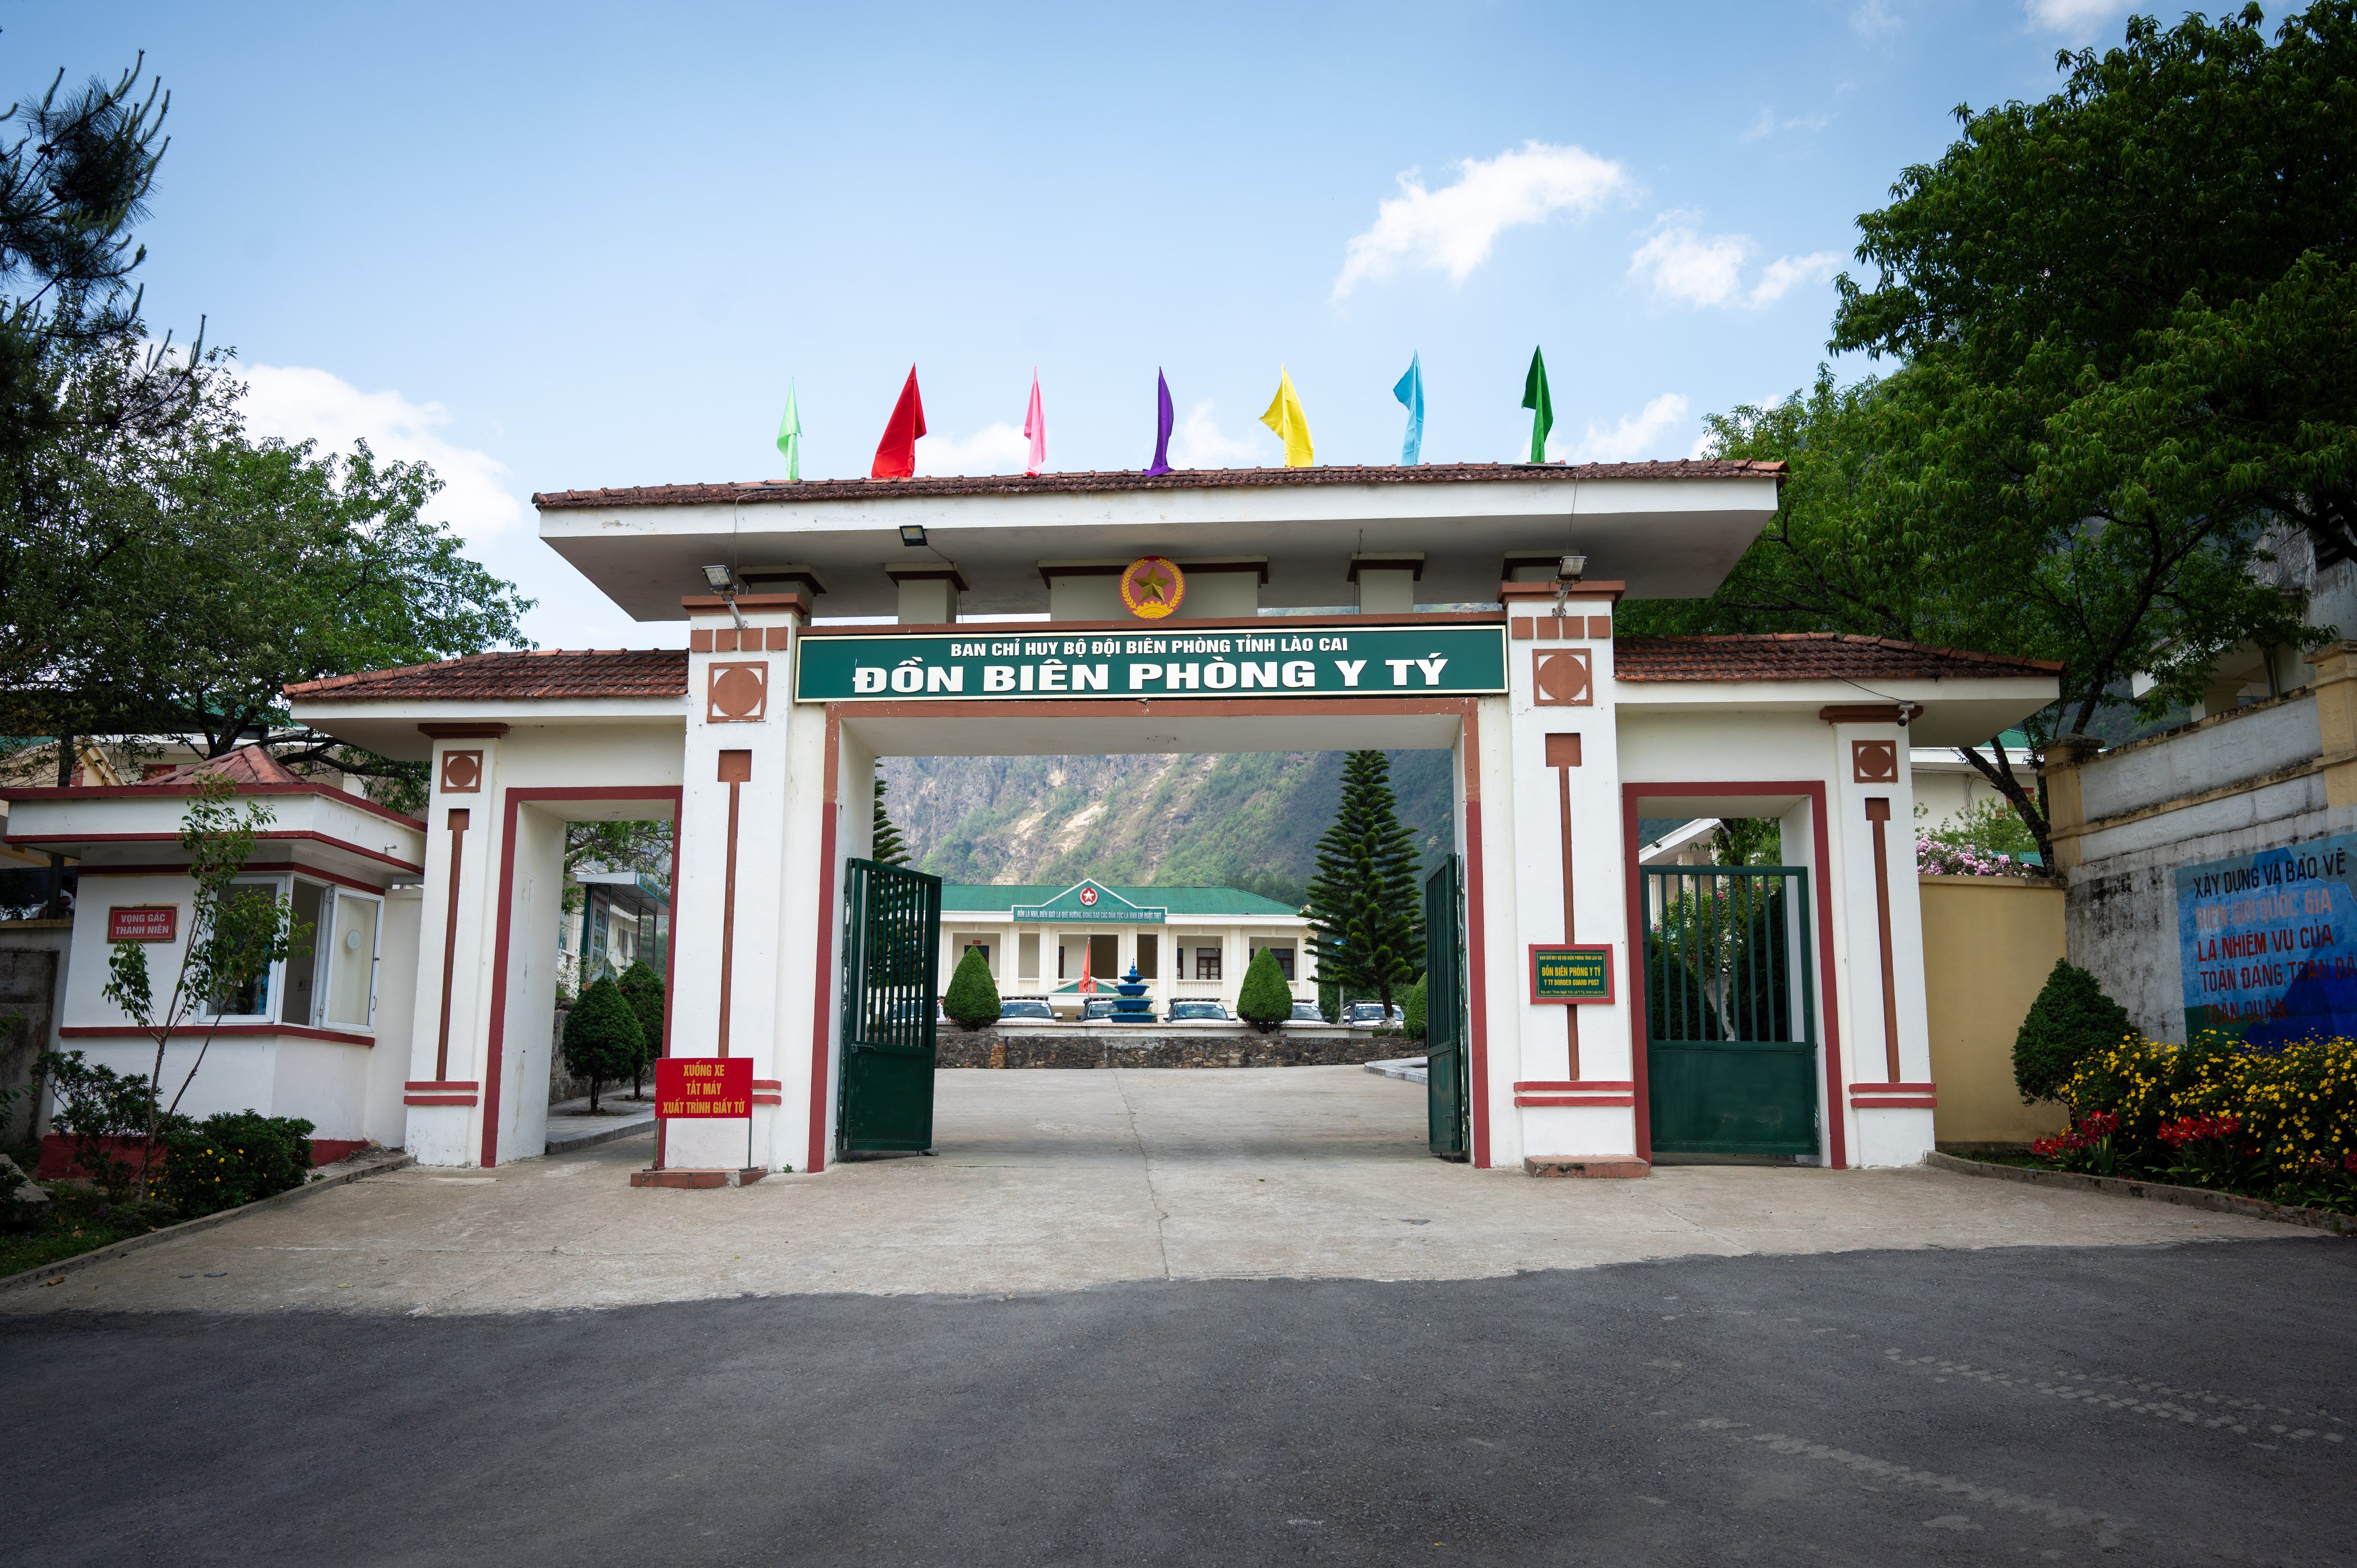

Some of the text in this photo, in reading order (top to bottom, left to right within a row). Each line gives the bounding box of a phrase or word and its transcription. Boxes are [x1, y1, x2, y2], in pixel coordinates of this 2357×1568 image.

[951, 634, 1348, 657] BAN CHỈ HUY BỘ ĐỘI BIÊN PHÒNG TỈNH LÀO CAI
[852, 652, 1449, 693] ĐỒN BIÊN PHÒNG Y TÝ
[2193, 847, 2346, 899] XÂY DỰNG VÀ BẢO VỆ
[121, 912, 165, 924] VỌNG GÁC
[1031, 909, 1039, 918] NHÀ,
[1039, 909, 1048, 918] BIÊN
[1056, 909, 1061, 918] LÀ
[1069, 911, 1082, 919] HƯƠNG,
[1083, 909, 1092, 919] ĐỒNG
[1124, 911, 1129, 919] LÀ
[1144, 911, 1153, 921] RUỘT
[2195, 887, 2332, 929] BIÊN GIỚI QUỐC GIA
[115, 924, 169, 934] THANH NIÊN
[2198, 918, 2334, 962] LÀ NHIỆM VỤ CỦA
[1555, 965, 1568, 976] BIÊN
[1569, 964, 1588, 976] PHÒNG
[1589, 967, 1593, 976] Y
[1594, 965, 1601, 976] TÝ
[2200, 951, 2357, 992] TOÀN ĐẢNG, TOÀN DÂ
[2203, 997, 2241, 1026] TOÀN
[683, 1060, 724, 1076] XUỐNG XE
[686, 1079, 721, 1095] TẮT MÁY
[663, 1097, 745, 1114] XUẤT TRÌNH GIẤY TỜ
